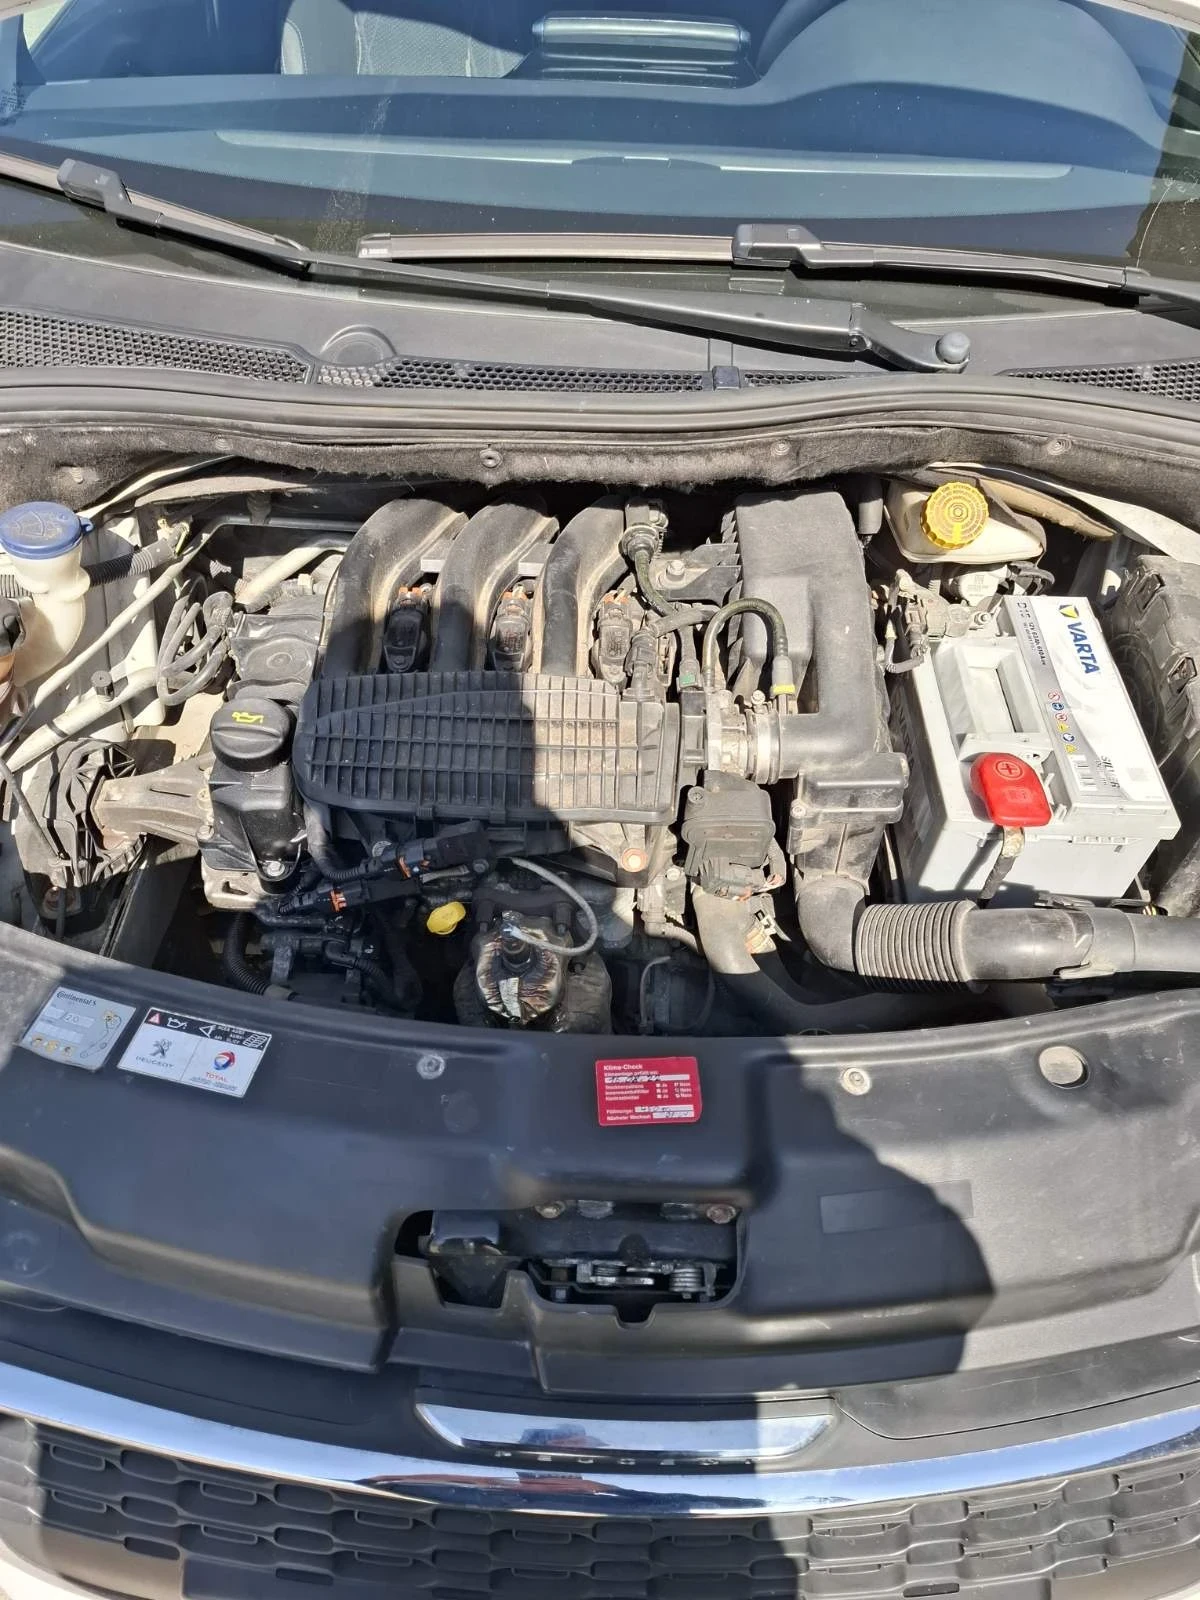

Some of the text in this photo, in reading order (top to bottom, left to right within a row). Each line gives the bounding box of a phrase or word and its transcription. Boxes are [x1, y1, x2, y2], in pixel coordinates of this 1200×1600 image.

[1067, 622, 1100, 674] VARTA
[136, 1056, 175, 1068] PEUGEOT
[206, 1072, 227, 1083] TOTAL
